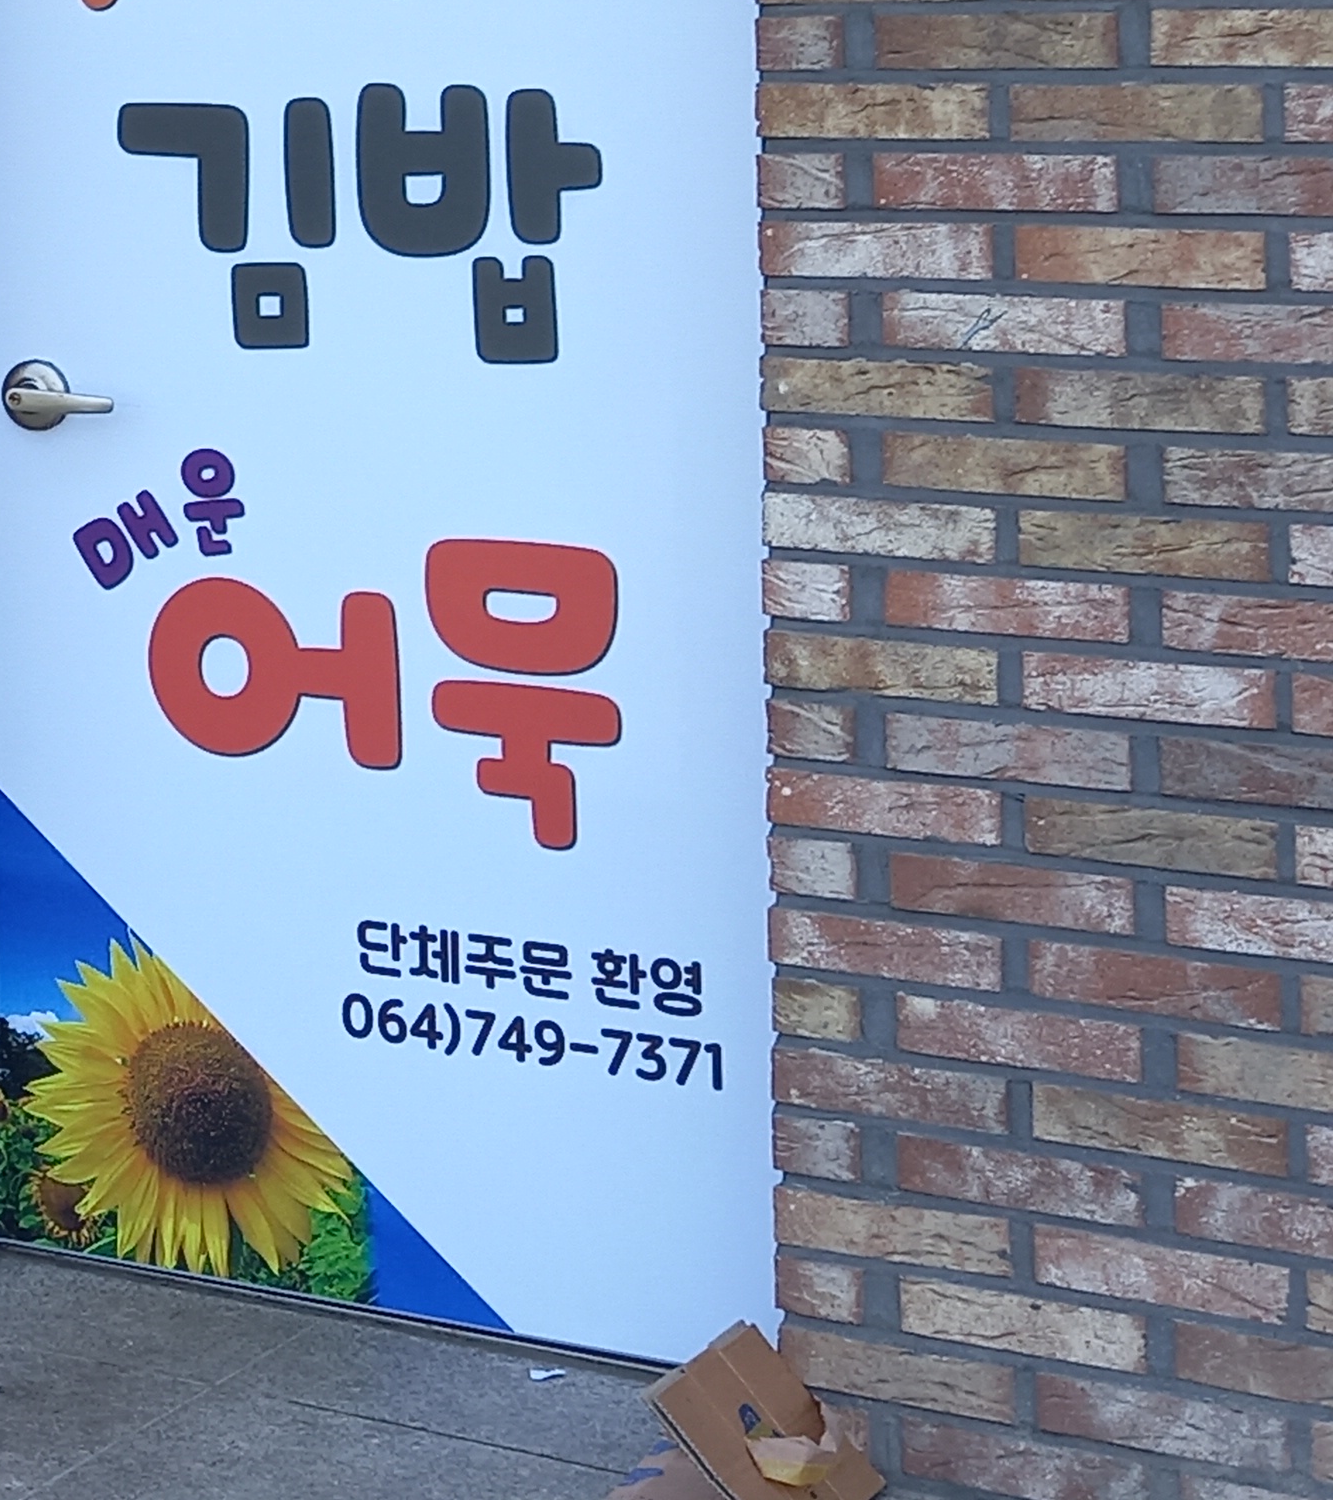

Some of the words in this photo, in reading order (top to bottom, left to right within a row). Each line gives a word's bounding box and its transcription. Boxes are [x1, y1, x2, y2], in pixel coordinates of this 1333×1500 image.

[116, 82, 604, 366] 김밥
[72, 447, 246, 591] 매운
[147, 537, 623, 852] 어묵
[356, 919, 573, 1001] 단체주문
[590, 947, 704, 1018] 환영
[341, 992, 725, 1092] 064)749-7371
